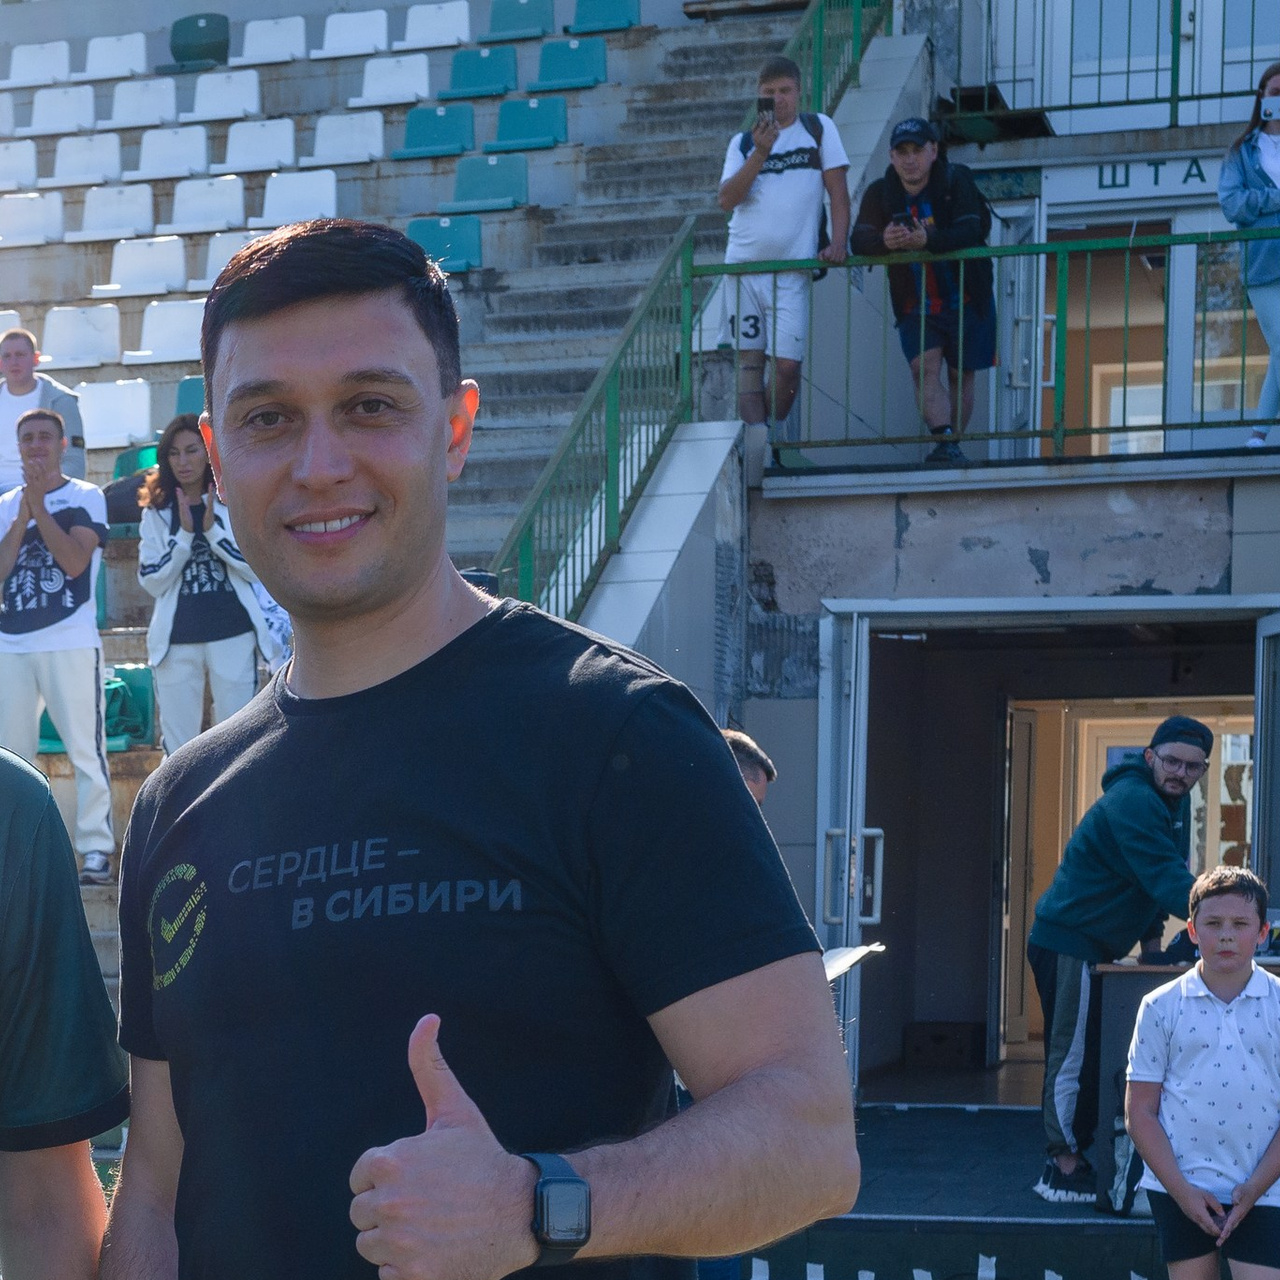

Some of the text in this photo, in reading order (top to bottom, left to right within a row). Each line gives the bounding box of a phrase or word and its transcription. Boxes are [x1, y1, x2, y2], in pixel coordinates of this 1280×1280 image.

[729, 314, 761, 339] 13
[227, 837, 389, 894] СЕРДЦЕ
[291, 878, 522, 930] В СИБИРИ
